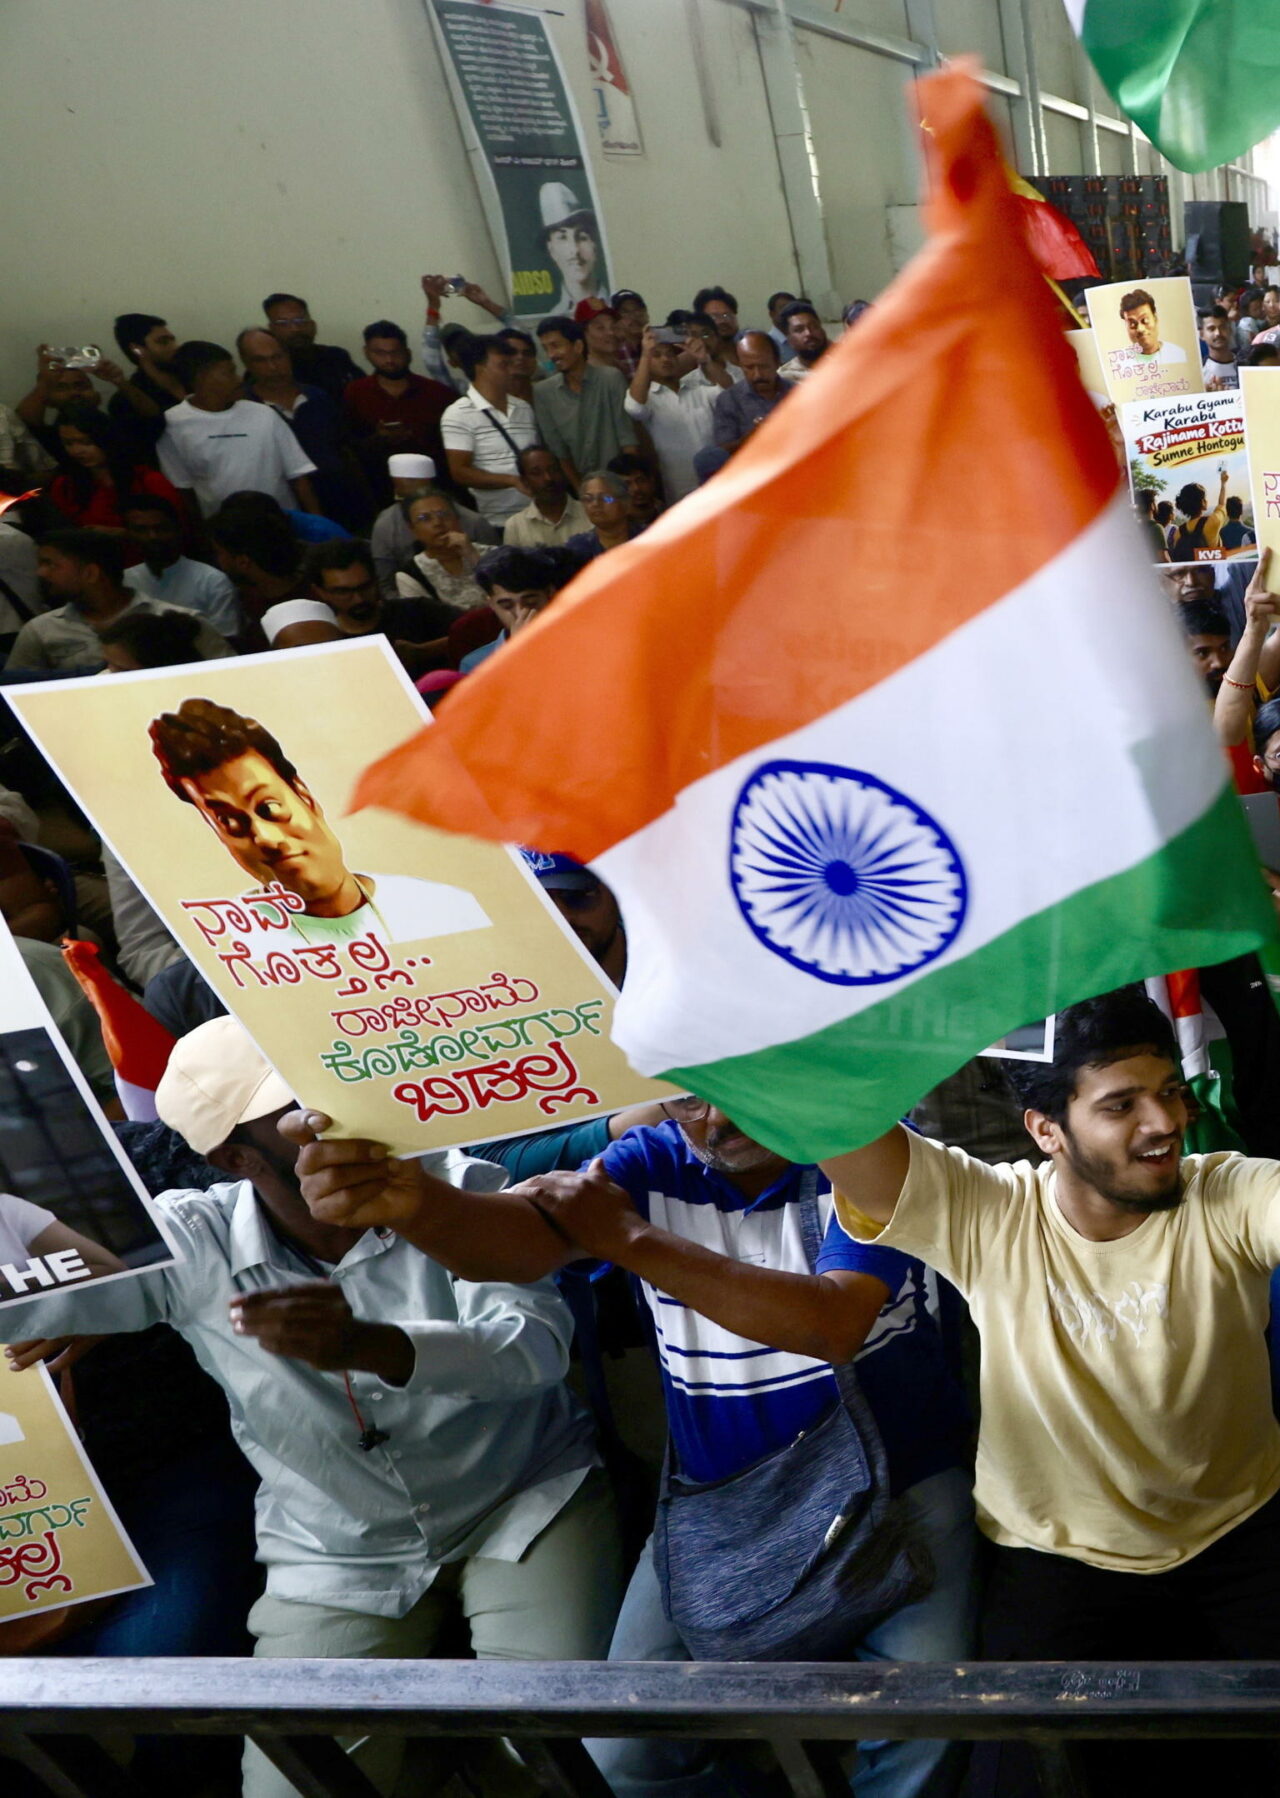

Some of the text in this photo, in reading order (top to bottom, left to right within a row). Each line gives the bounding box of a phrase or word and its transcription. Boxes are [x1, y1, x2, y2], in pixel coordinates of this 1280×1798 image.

[1143, 397, 1234, 423] Karabu Gyanu
[1164, 411, 1216, 431] Karabu
[1141, 419, 1245, 452] Rajiname Kottu
[1153, 436, 1245, 467] Sumne Hontogu
[1198, 549, 1222, 560] KVS
[394, 1041, 600, 1122] ಬಿಡಲ್ಲ
[0, 1248, 92, 1295] HE
